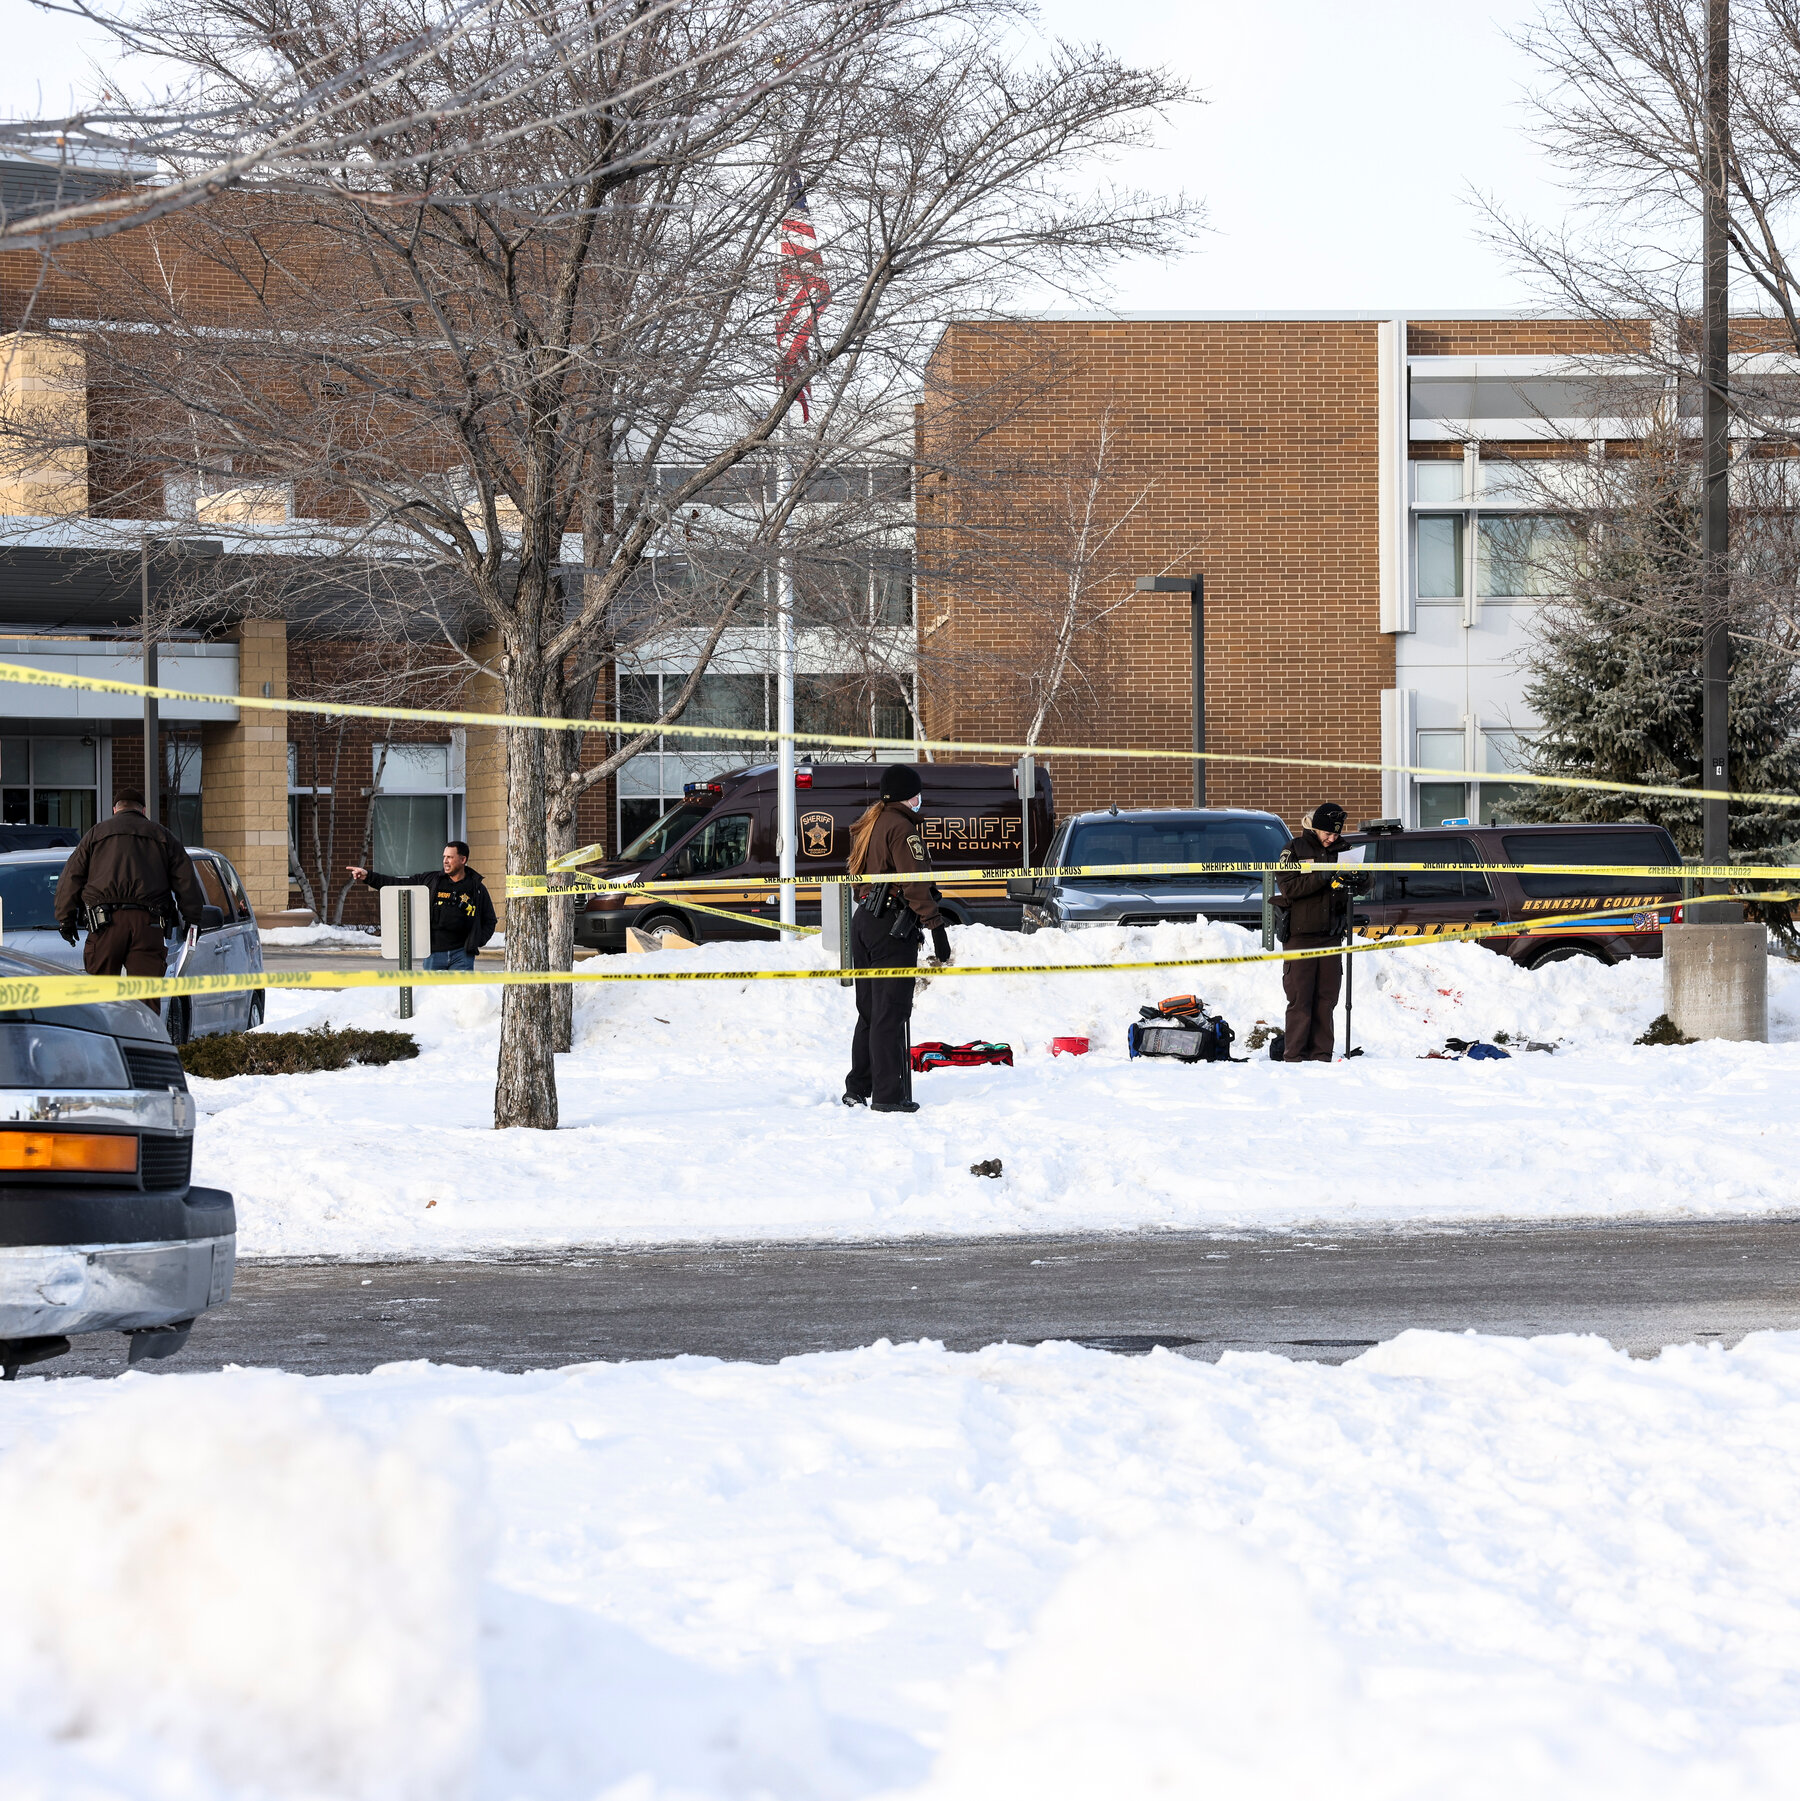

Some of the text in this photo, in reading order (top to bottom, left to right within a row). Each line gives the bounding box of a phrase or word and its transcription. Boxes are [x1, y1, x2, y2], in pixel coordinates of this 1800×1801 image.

[802, 815, 832, 825] SHERIFF
[916, 817, 1022, 839] ERIFF
[958, 841, 1022, 850] COUNTY
[1201, 862, 1235, 871] SHERIFF'S
[1237, 862, 1251, 870] LINE
[1253, 862, 1263, 870] DO
[1265, 862, 1277, 870] NOT
[1280, 861, 1302, 870] CROSS
[982, 866, 1082, 878] SHERIFF'S LINE DO NOT CROSS
[1521, 896, 1663, 911] HENNEPIN COUNTY
